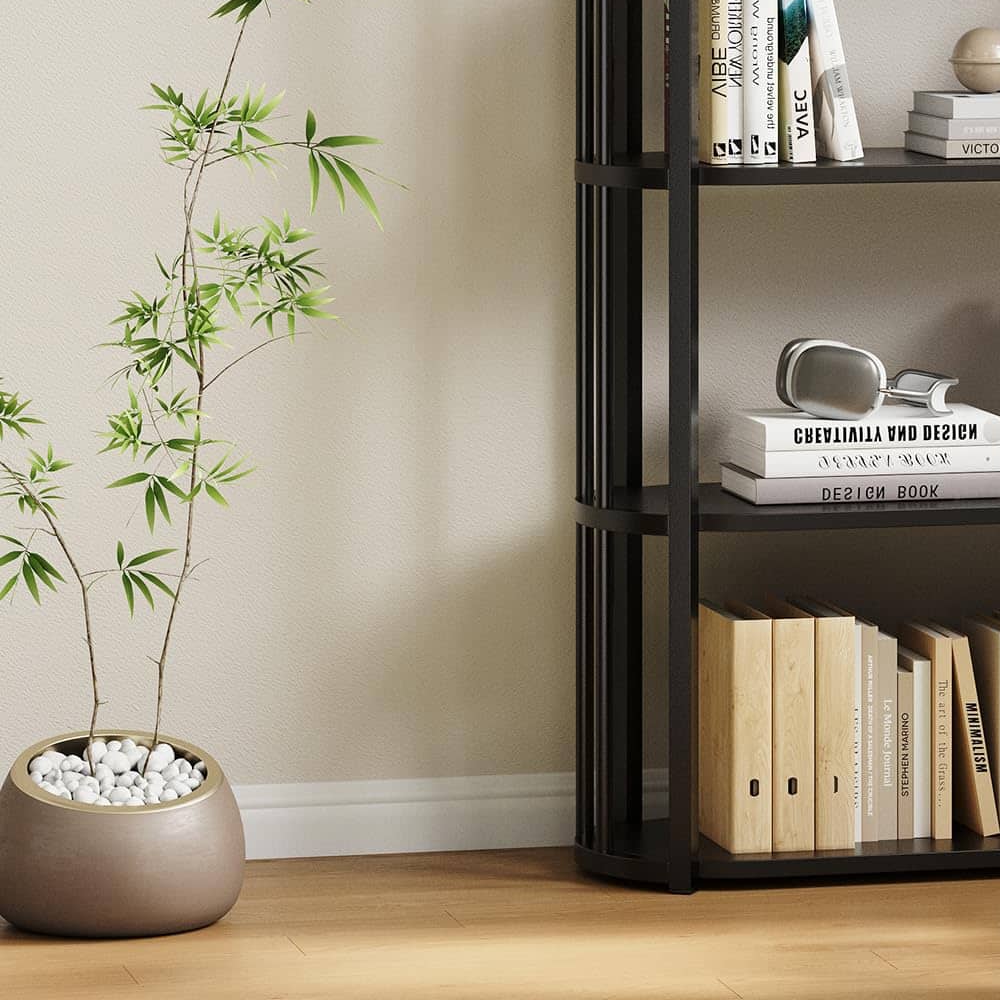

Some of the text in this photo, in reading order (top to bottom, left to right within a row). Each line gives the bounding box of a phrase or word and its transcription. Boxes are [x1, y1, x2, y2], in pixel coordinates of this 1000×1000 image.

[938, 680, 948, 698] The
[938, 702, 948, 718] art
[938, 723, 948, 736] of
[965, 702, 988, 773] MINIMALISM
[882, 700, 892, 787] Le Monde Journal
[938, 742, 948, 760] the
